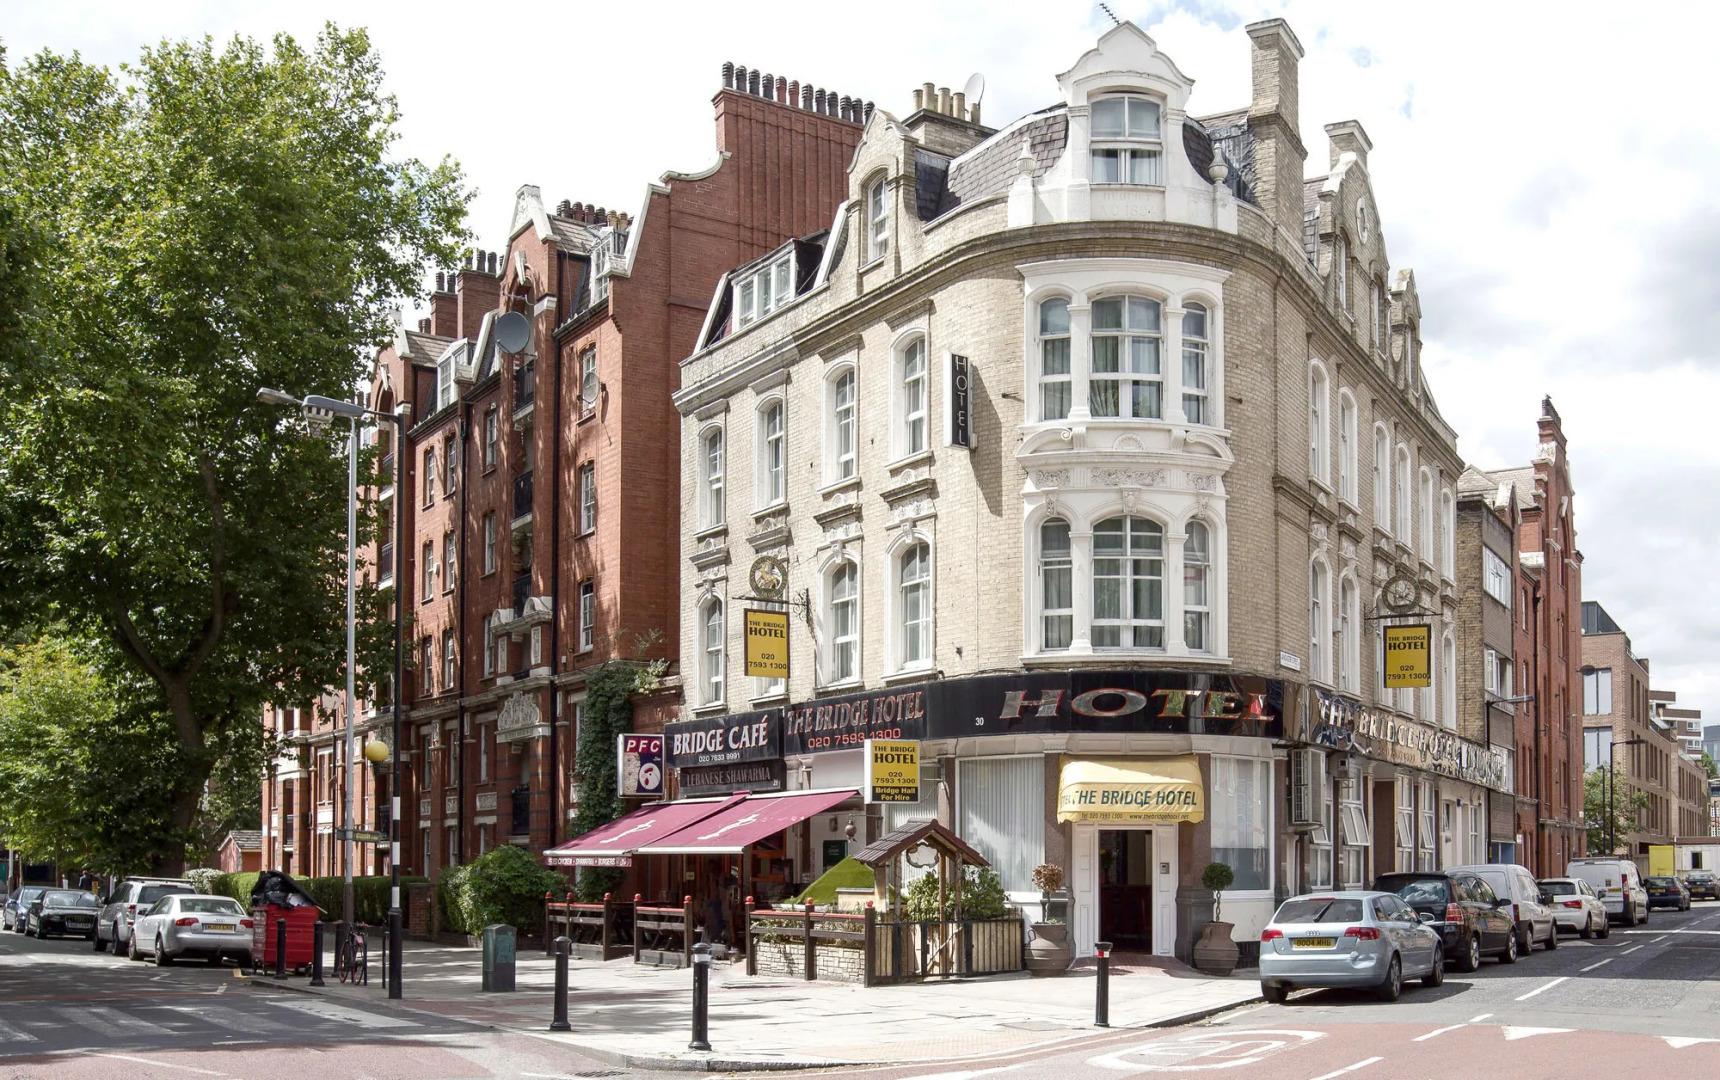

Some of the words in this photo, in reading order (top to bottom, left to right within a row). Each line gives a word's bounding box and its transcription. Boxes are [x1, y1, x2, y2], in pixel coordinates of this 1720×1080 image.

[955, 355, 968, 445] HOTEL
[749, 627, 785, 638] HOTEL
[1388, 641, 1426, 651] HOTEL
[1408, 672, 1428, 680] 1300
[998, 687, 1276, 722] HOTEL
[787, 707, 813, 736] THE
[814, 699, 869, 731] BRIDGE
[871, 691, 924, 725] HOTEL
[975, 716, 984, 727] 30
[673, 729, 724, 756] BRIDGE
[728, 714, 769, 750] CAFÉ
[808, 736, 831, 749] 020
[834, 732, 865, 746] 7593
[869, 727, 902, 740] 1300
[626, 739, 661, 753] PFC
[698, 755, 710, 763] 020
[874, 753, 917, 764] HOTEL
[686, 771, 724, 787] LEBANESE
[726, 767, 771, 784] SHAWARMA
[875, 787, 900, 795] Bridge
[1100, 790, 1153, 806] BRIDGE
[1155, 790, 1197, 806] HOTEL
